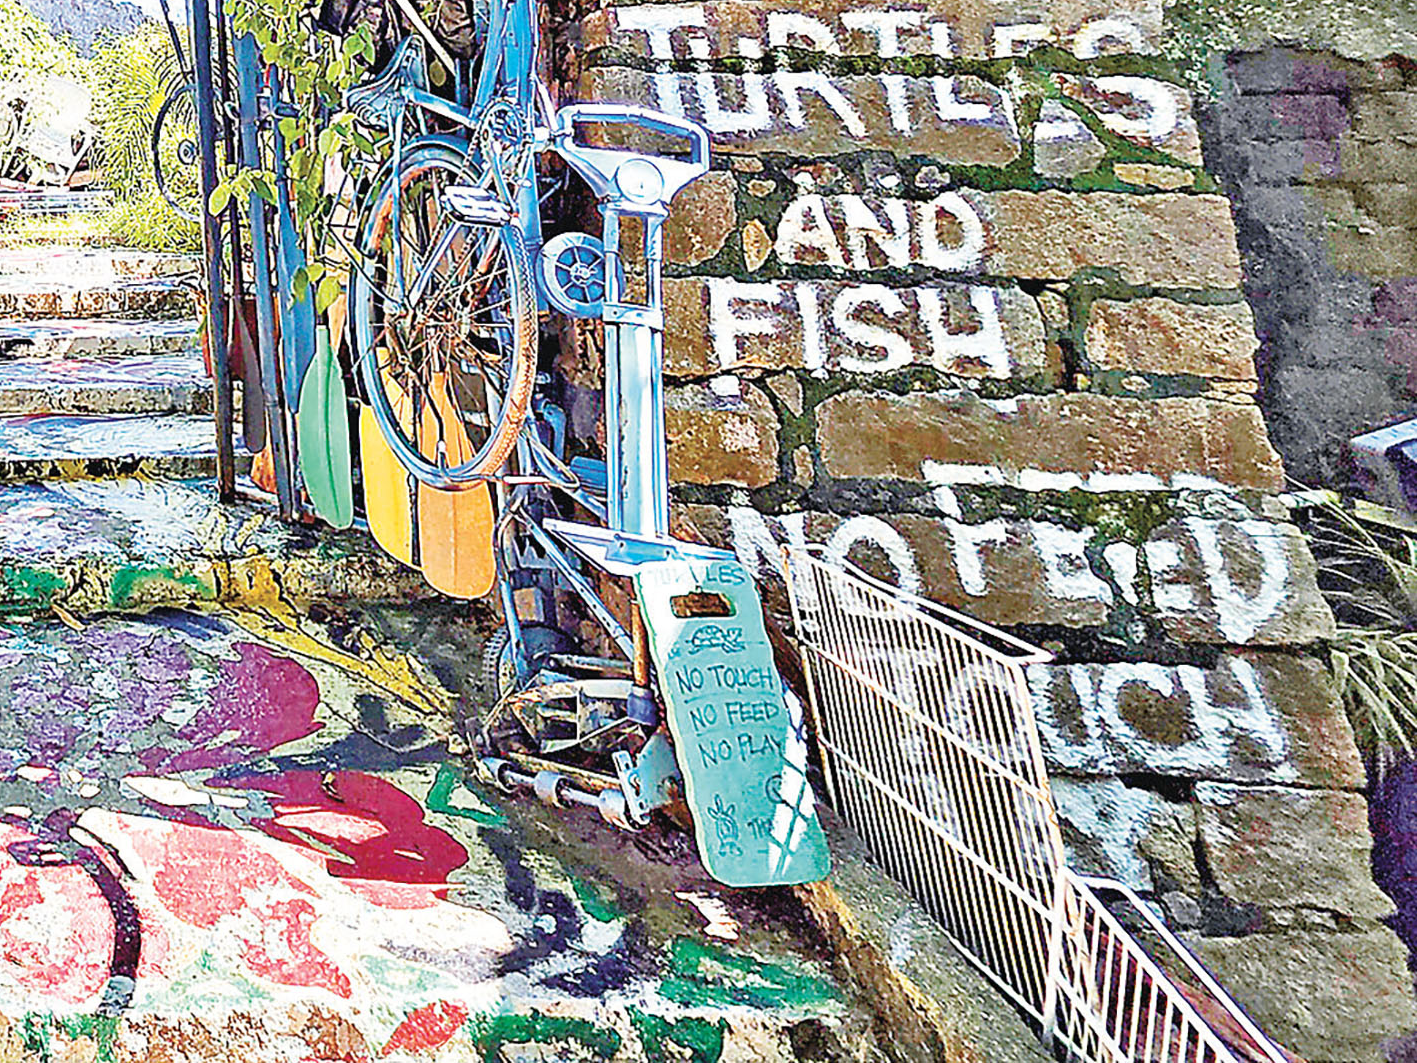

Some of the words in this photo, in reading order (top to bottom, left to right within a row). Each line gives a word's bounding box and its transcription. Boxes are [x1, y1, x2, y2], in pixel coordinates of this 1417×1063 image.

[616, 4, 1179, 145] TURTLES
[775, 189, 985, 273] AND
[707, 280, 1012, 383] FISH
[675, 665, 704, 694] NO
[707, 664, 775, 690] TOUCH
[689, 703, 718, 732] NO
[726, 701, 780, 728] FEED
[699, 741, 732, 770] NO
[737, 732, 784, 761] PLAY
